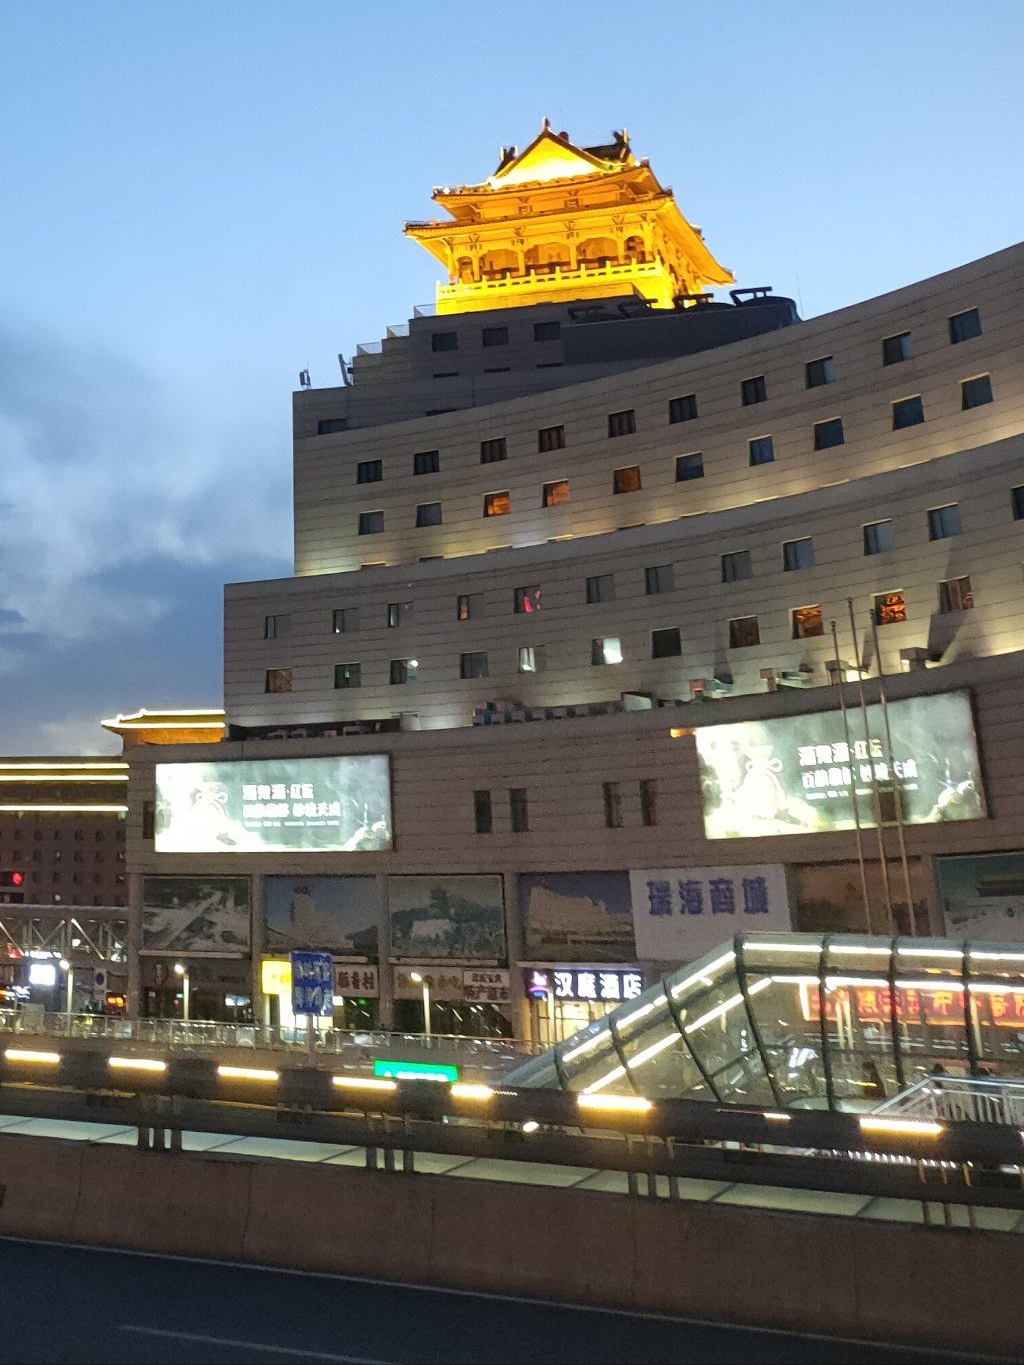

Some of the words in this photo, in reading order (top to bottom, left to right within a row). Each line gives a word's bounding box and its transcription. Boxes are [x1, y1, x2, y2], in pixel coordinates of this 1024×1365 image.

[647, 877, 769, 916] 瑞海商城
[554, 972, 641, 1000] 汉庭酒店
